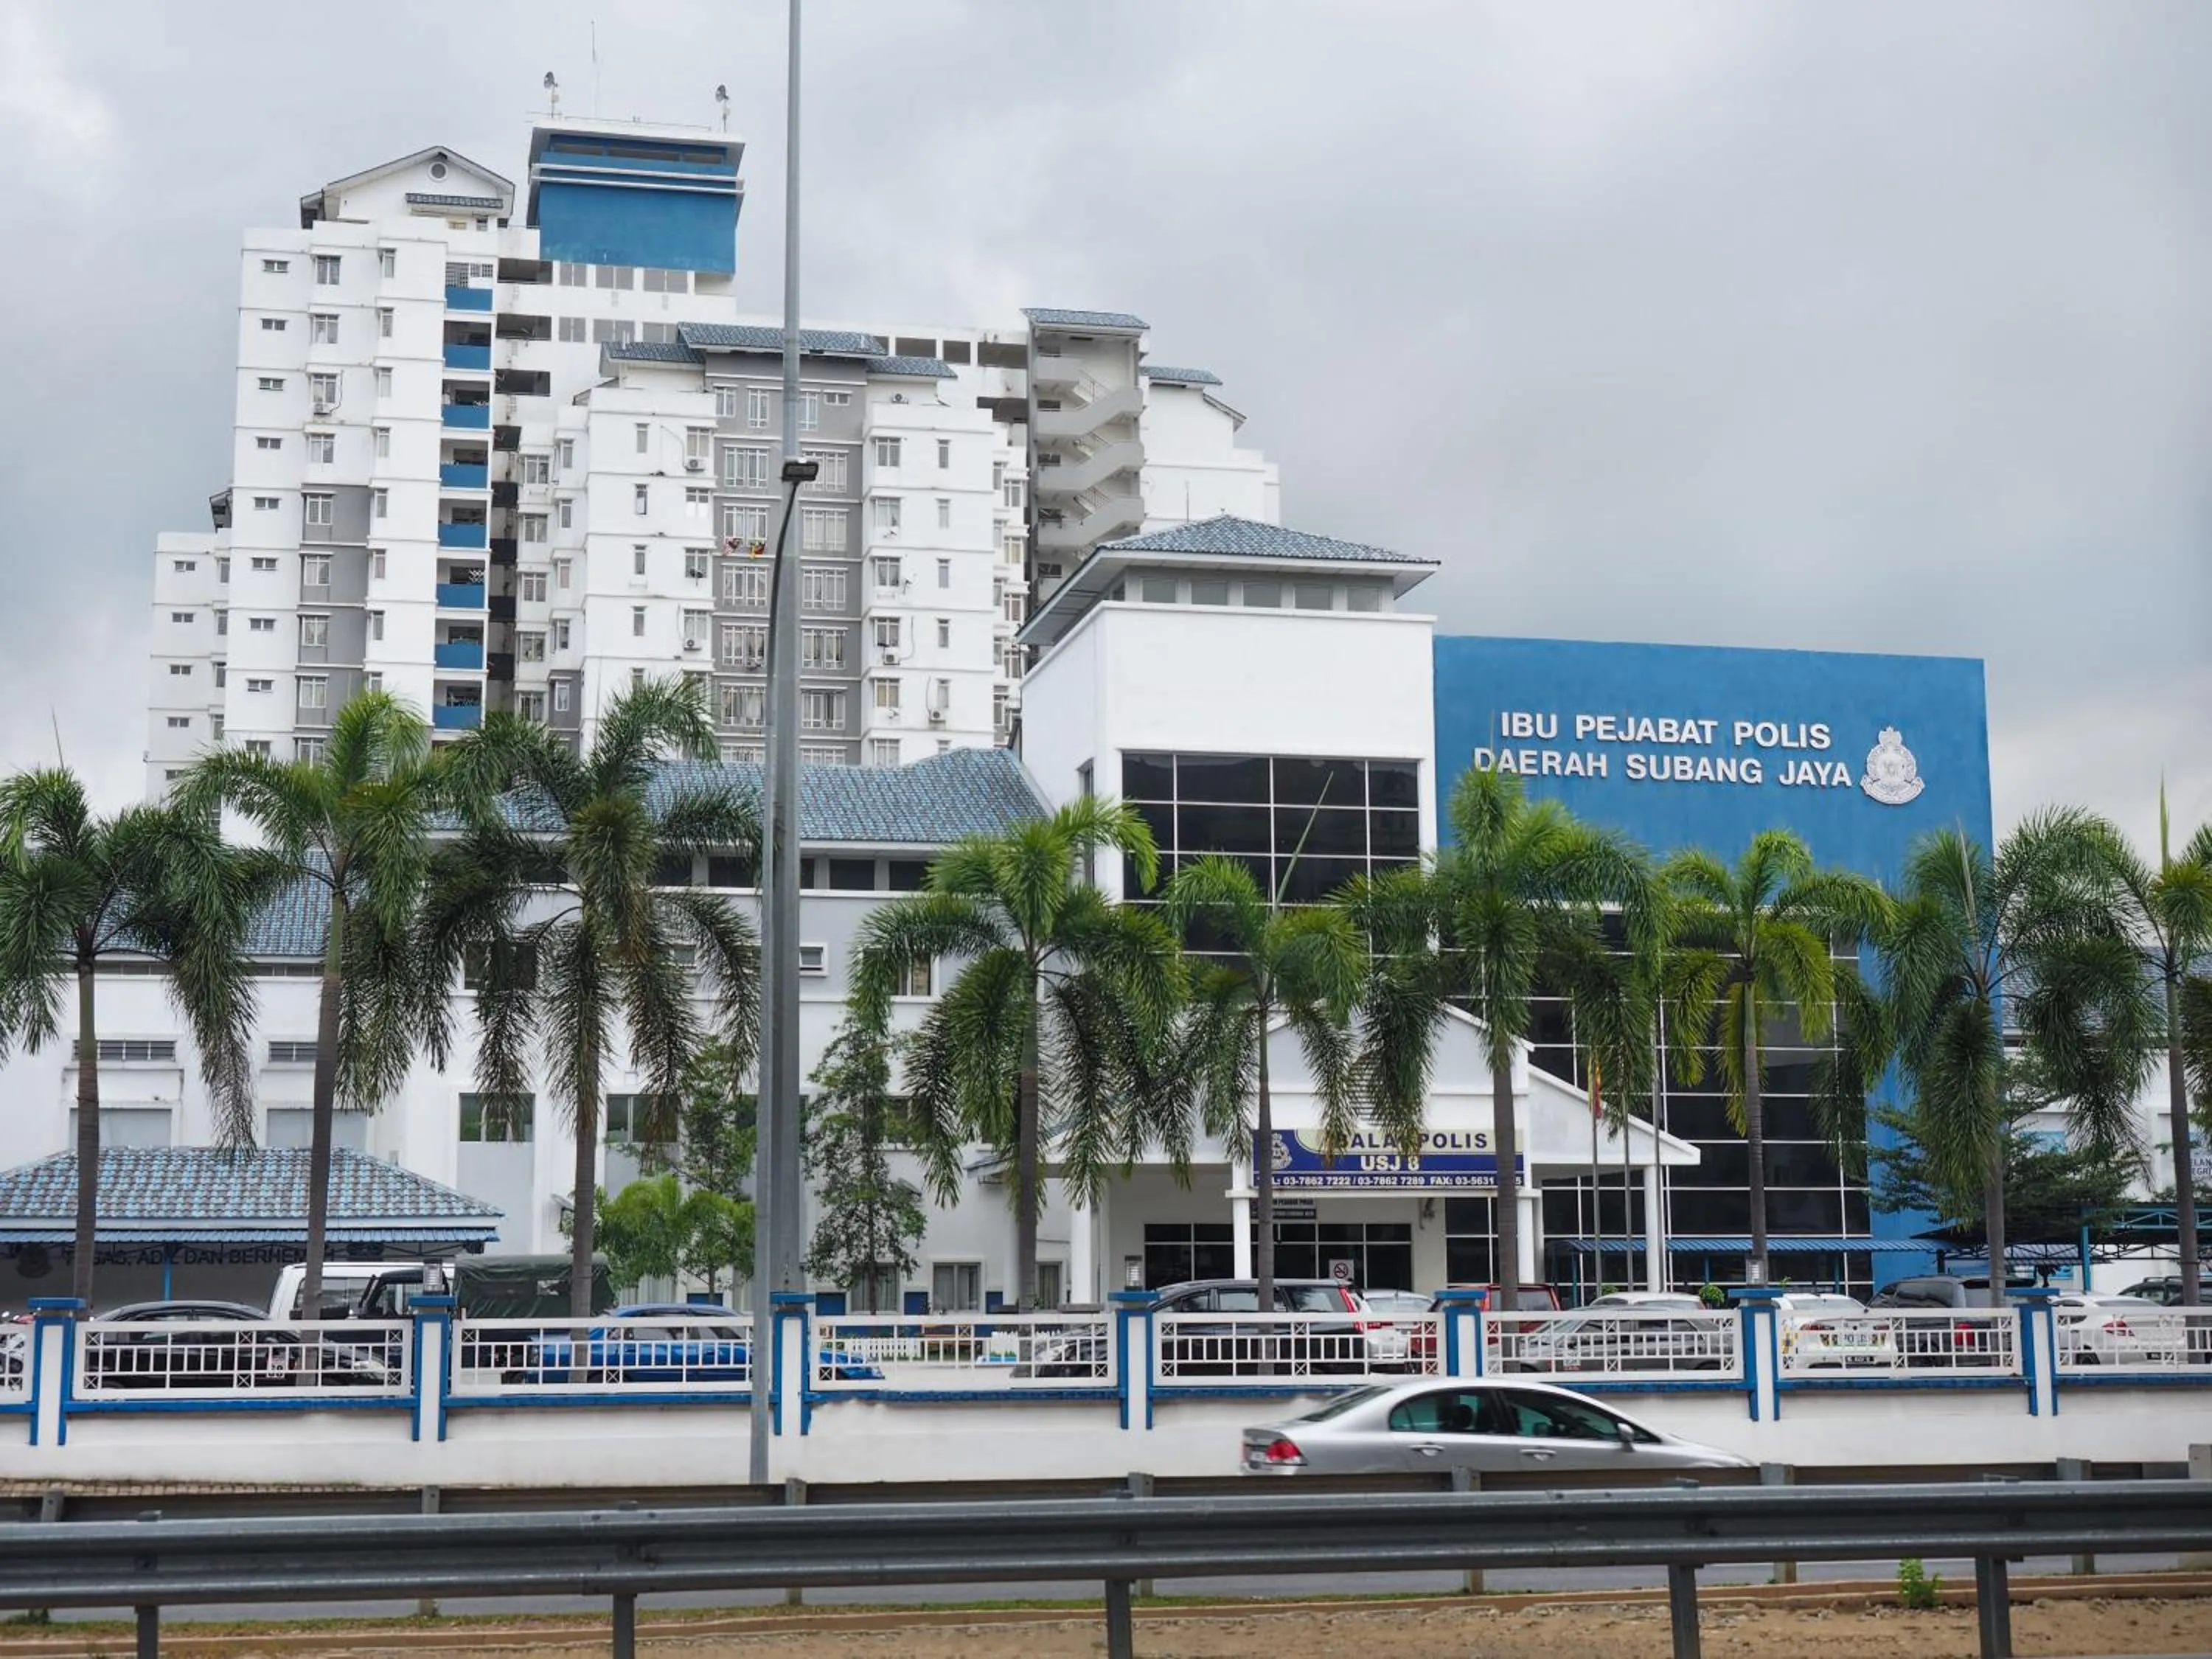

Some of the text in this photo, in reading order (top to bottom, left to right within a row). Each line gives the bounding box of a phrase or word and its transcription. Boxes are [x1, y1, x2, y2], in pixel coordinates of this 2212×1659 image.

[1500, 712, 1832, 750] IBU PEJABAT POLIS
[1474, 747, 1853, 787] DAERAH SUBANG JAYA
[1338, 1133, 1488, 1149] BALA POLIS
[1360, 1155, 1401, 1171] USJ
[1282, 1176, 1324, 1185] 03-7862
[1326, 1176, 1351, 1185] 7222
[1357, 1176, 1397, 1185] 03-7862
[1401, 1176, 1425, 1185] 7289
[1430, 1176, 1453, 1185] FAX:
[184, 1250, 223, 1265] DAN
